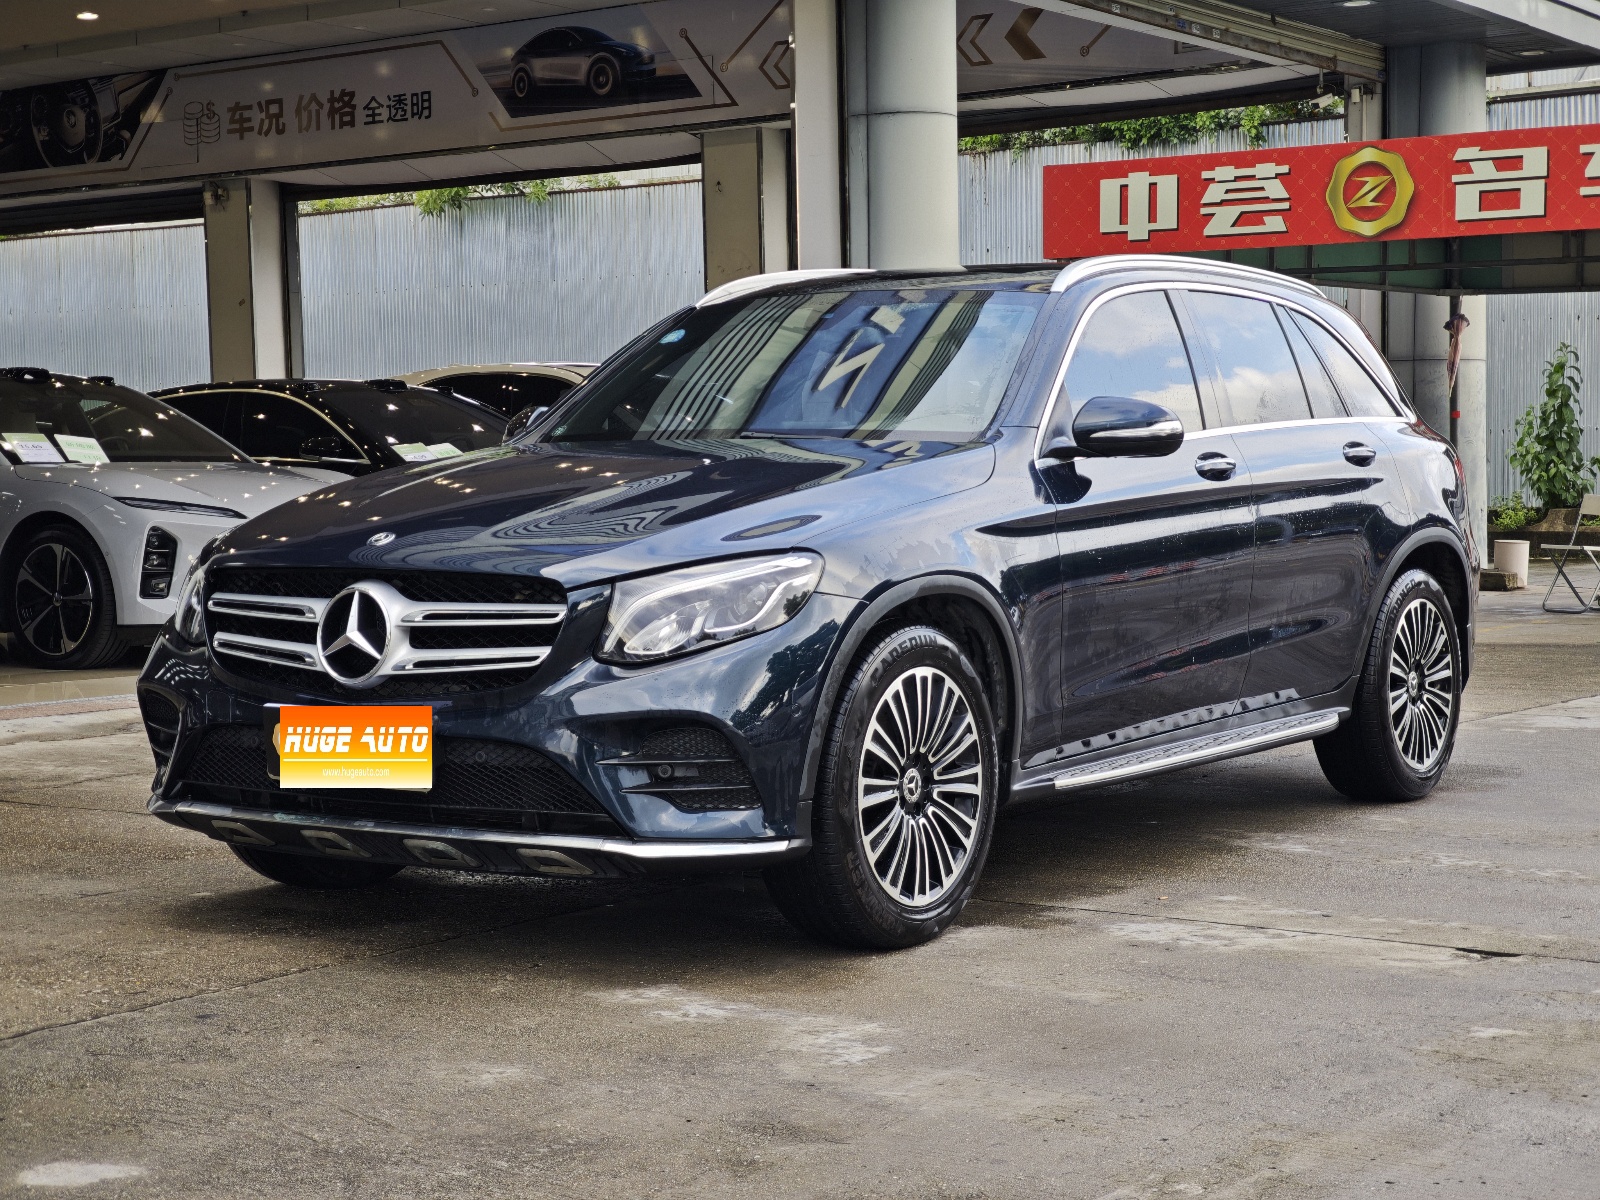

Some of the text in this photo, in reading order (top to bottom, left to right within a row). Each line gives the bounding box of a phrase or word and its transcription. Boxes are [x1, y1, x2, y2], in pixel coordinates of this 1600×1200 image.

[226, 88, 432, 141] 车况 价格 全透明
[1100, 162, 1291, 241] 中荟
[1451, 143, 1600, 222] 名
